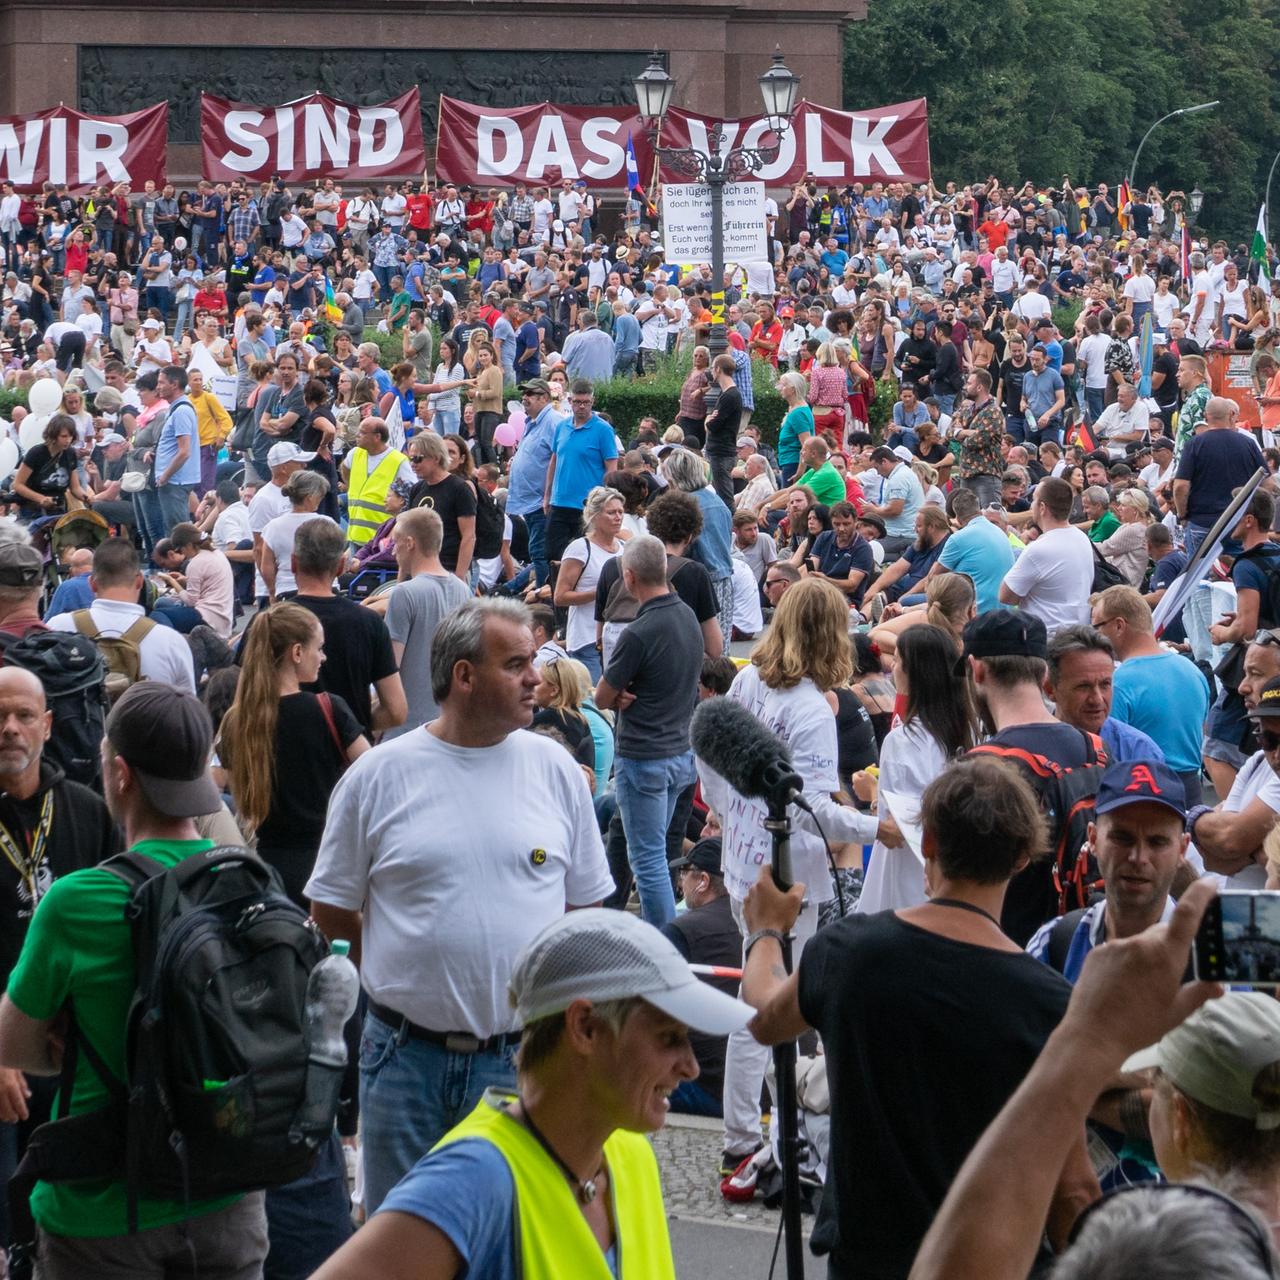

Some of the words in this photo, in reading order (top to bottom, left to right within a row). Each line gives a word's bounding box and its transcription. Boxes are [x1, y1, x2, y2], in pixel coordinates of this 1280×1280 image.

[220, 104, 404, 172] SIND
[477, 114, 626, 180] DAS
[686, 111, 905, 181] VOLK
[666, 187, 683, 196] Sie
[722, 186, 741, 195] uch
[743, 186, 759, 196] an,
[670, 200, 690, 208] doch
[737, 198, 757, 206] nicht
[668, 224, 685, 232] Erst
[672, 234, 692, 243] Euch
[674, 246, 690, 254] das
[1123, 764, 1163, 795] A
